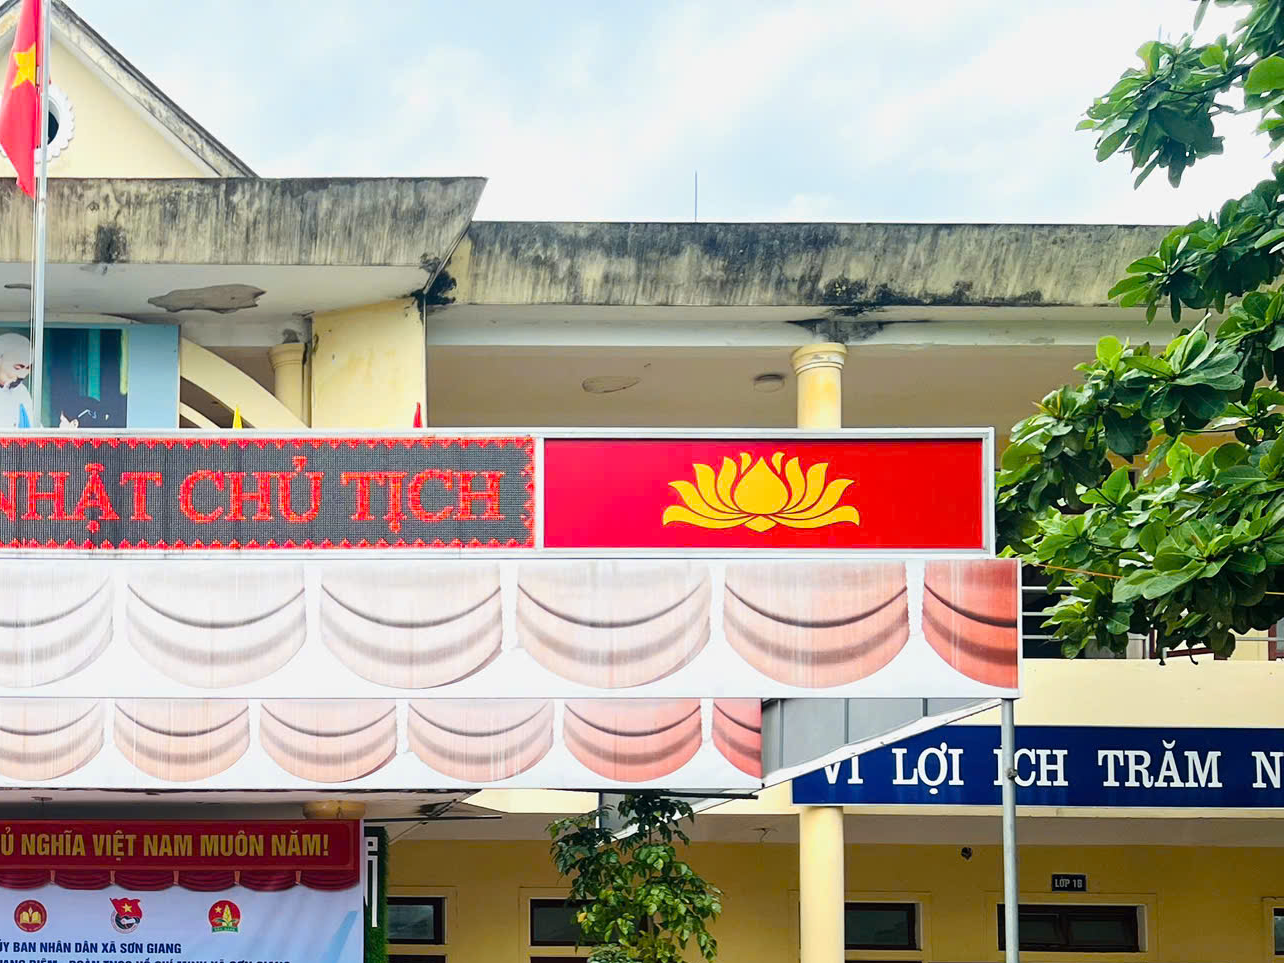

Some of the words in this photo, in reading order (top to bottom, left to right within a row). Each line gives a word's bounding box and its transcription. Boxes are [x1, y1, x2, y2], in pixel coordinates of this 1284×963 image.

[179, 456, 325, 525] CHỦ
[340, 468, 505, 533] TỊCH
[891, 742, 965, 795] LỢI
[1097, 739, 1223, 789] TRĂM
[21, 830, 86, 856] NGHĨA
[92, 830, 137, 861] VIỆT
[143, 834, 193, 857] NAM
[200, 831, 264, 857] MUÔN
[271, 829, 330, 857] NĂM!
[13, 942, 37, 953] BAN
[39, 940, 72, 954] NHÂN
[74, 940, 98, 954] DÂN
[101, 941, 117, 955] XÃ
[120, 942, 142, 955] SƠN
[146, 943, 182, 955] GIANG
